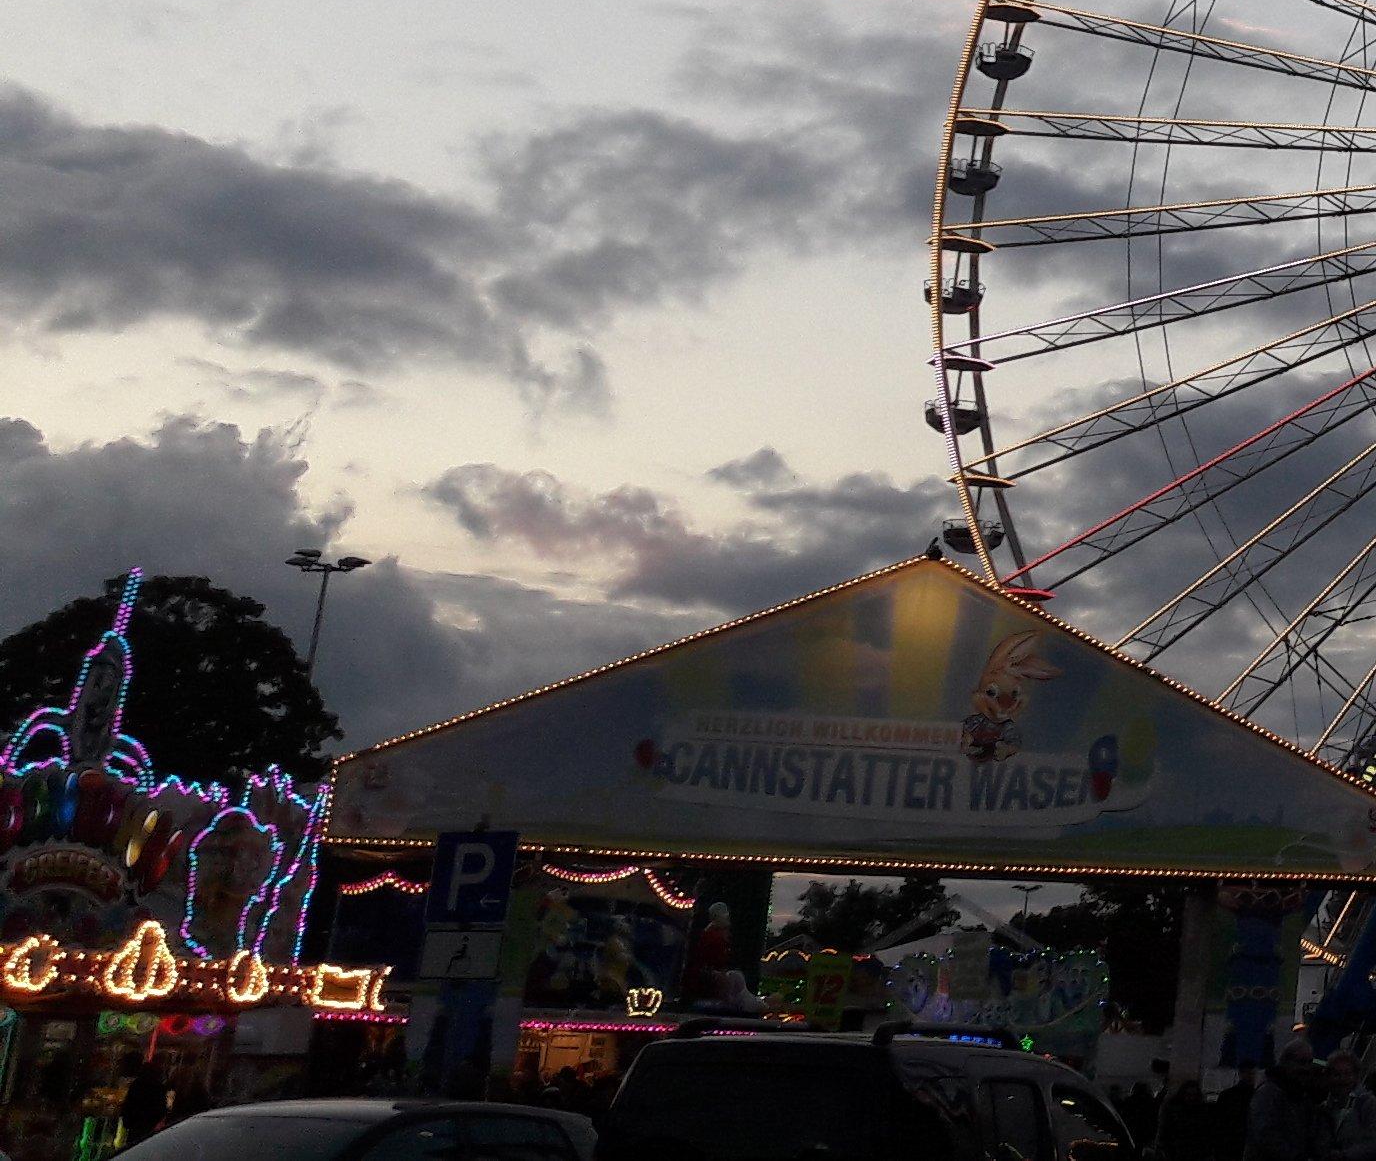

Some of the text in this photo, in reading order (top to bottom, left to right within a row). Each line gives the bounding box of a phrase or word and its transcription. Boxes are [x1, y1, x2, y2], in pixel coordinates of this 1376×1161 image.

[696, 715, 960, 745] HERZLICH WILLKOMMEN
[667, 742, 957, 810] CANNSTATTER
[448, 842, 496, 911] P
